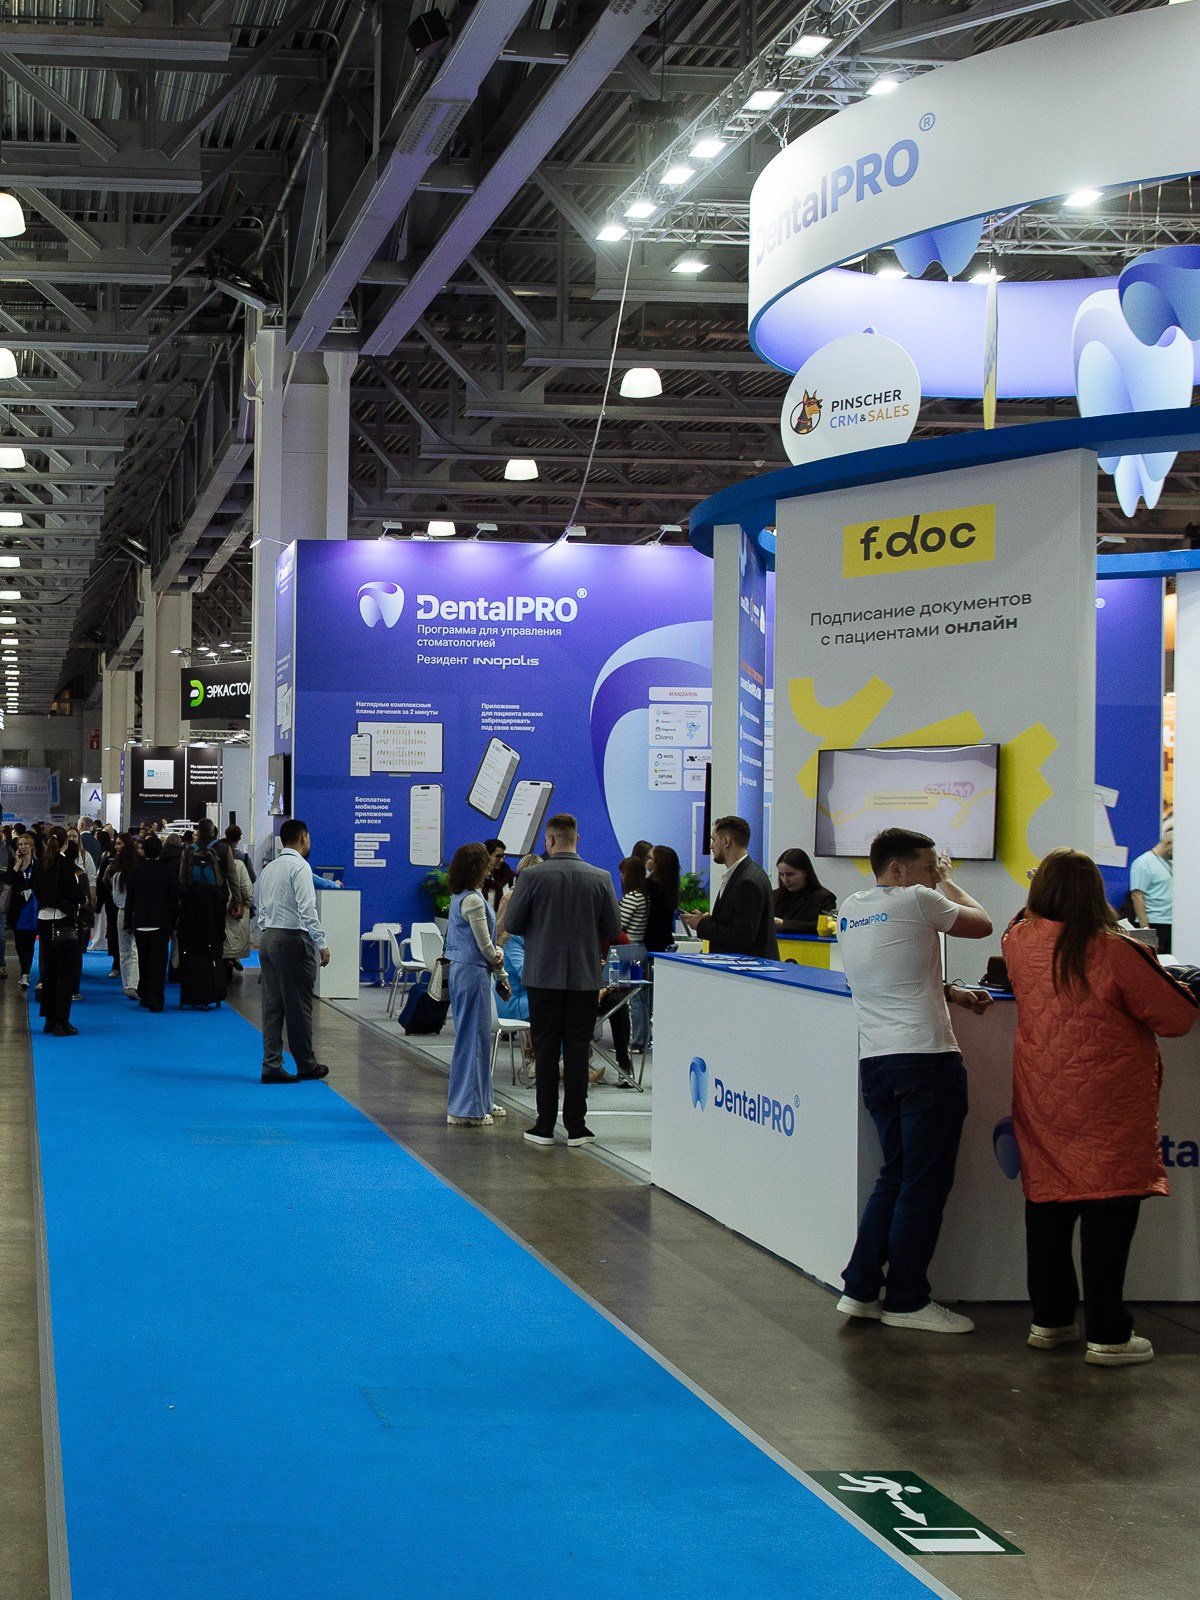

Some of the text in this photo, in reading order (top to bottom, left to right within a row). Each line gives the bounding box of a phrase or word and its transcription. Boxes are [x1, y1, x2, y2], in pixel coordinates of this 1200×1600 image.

[831, 389, 902, 412] PINSCHER
[860, 515, 976, 561] f.doc
[810, 593, 1032, 626] Подписание документов
[417, 625, 562, 637] Программа для управления
[821, 615, 1018, 646] с пациентами онлайн
[417, 638, 496, 648] стоматологией
[417, 654, 468, 666] Резидент
[849, 912, 888, 929] DentalPRO
